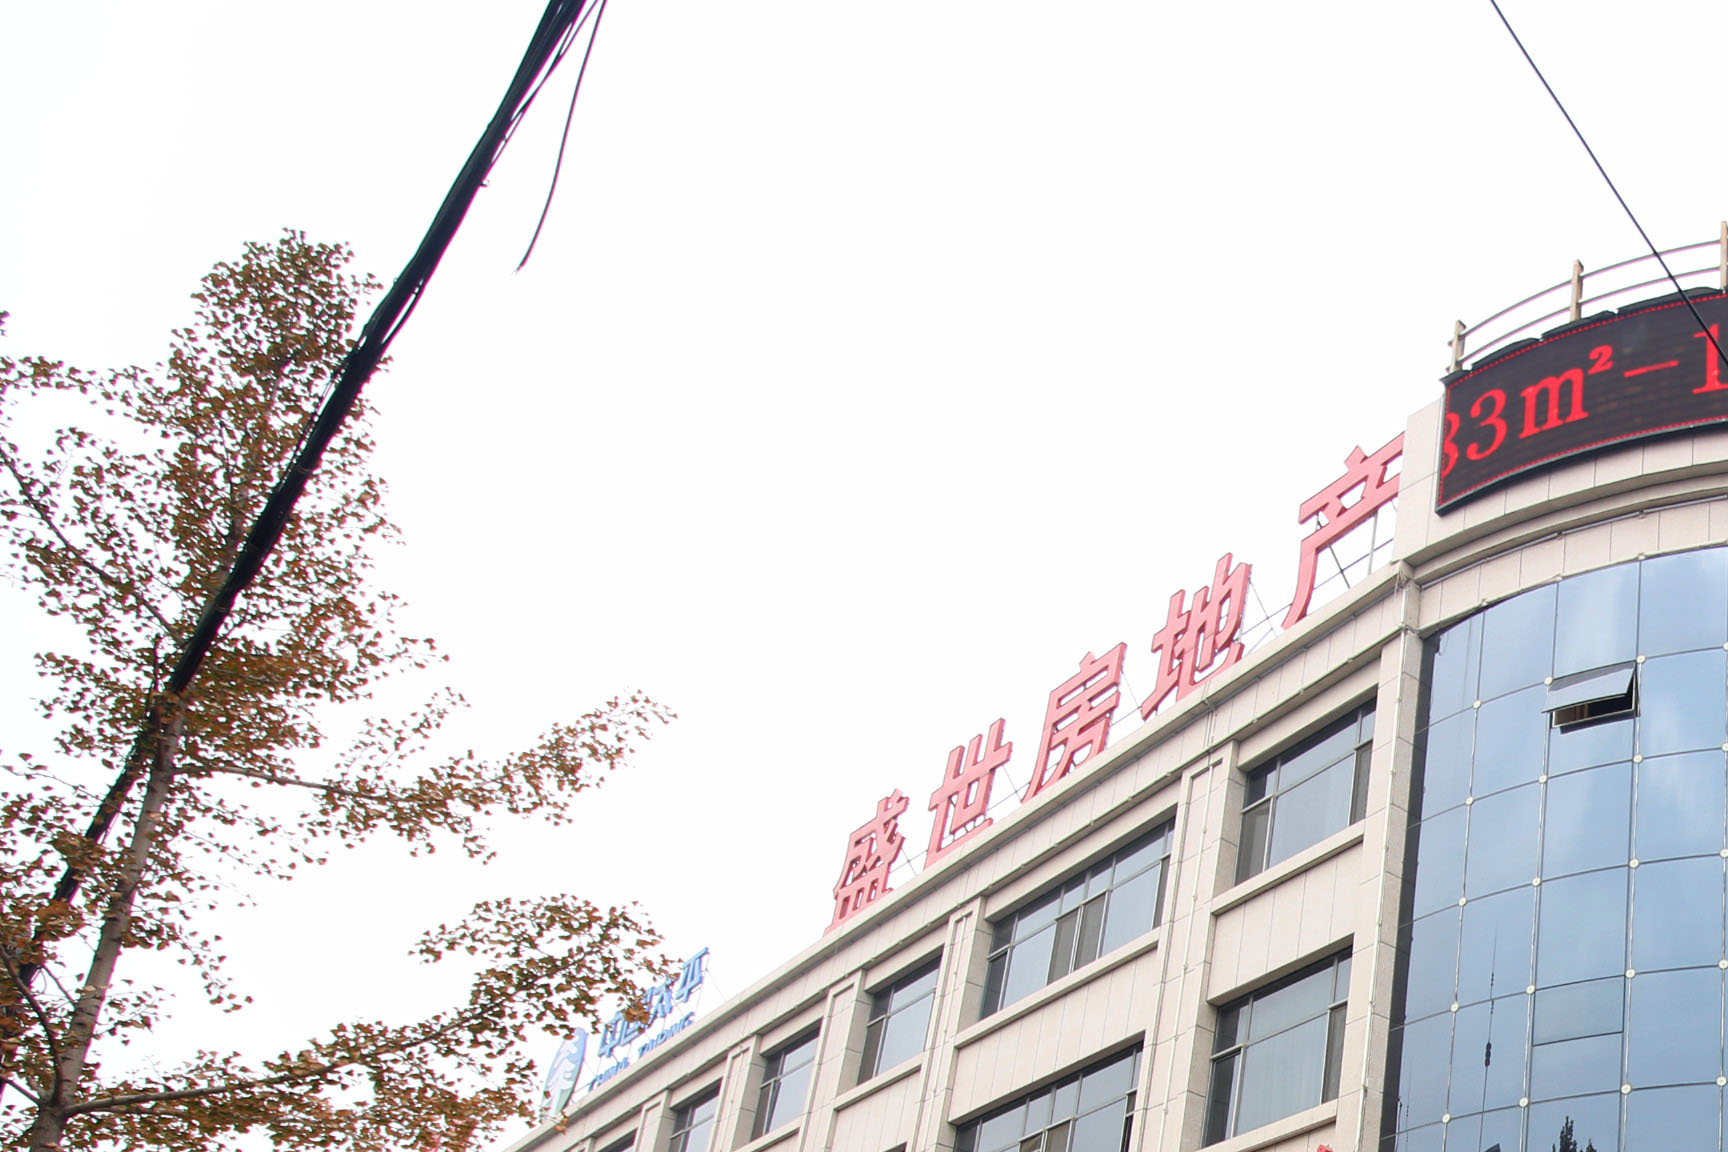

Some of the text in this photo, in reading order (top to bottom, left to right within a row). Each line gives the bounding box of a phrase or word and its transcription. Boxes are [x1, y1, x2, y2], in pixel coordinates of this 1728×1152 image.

[823, 431, 1405, 937] 盛世房地产
